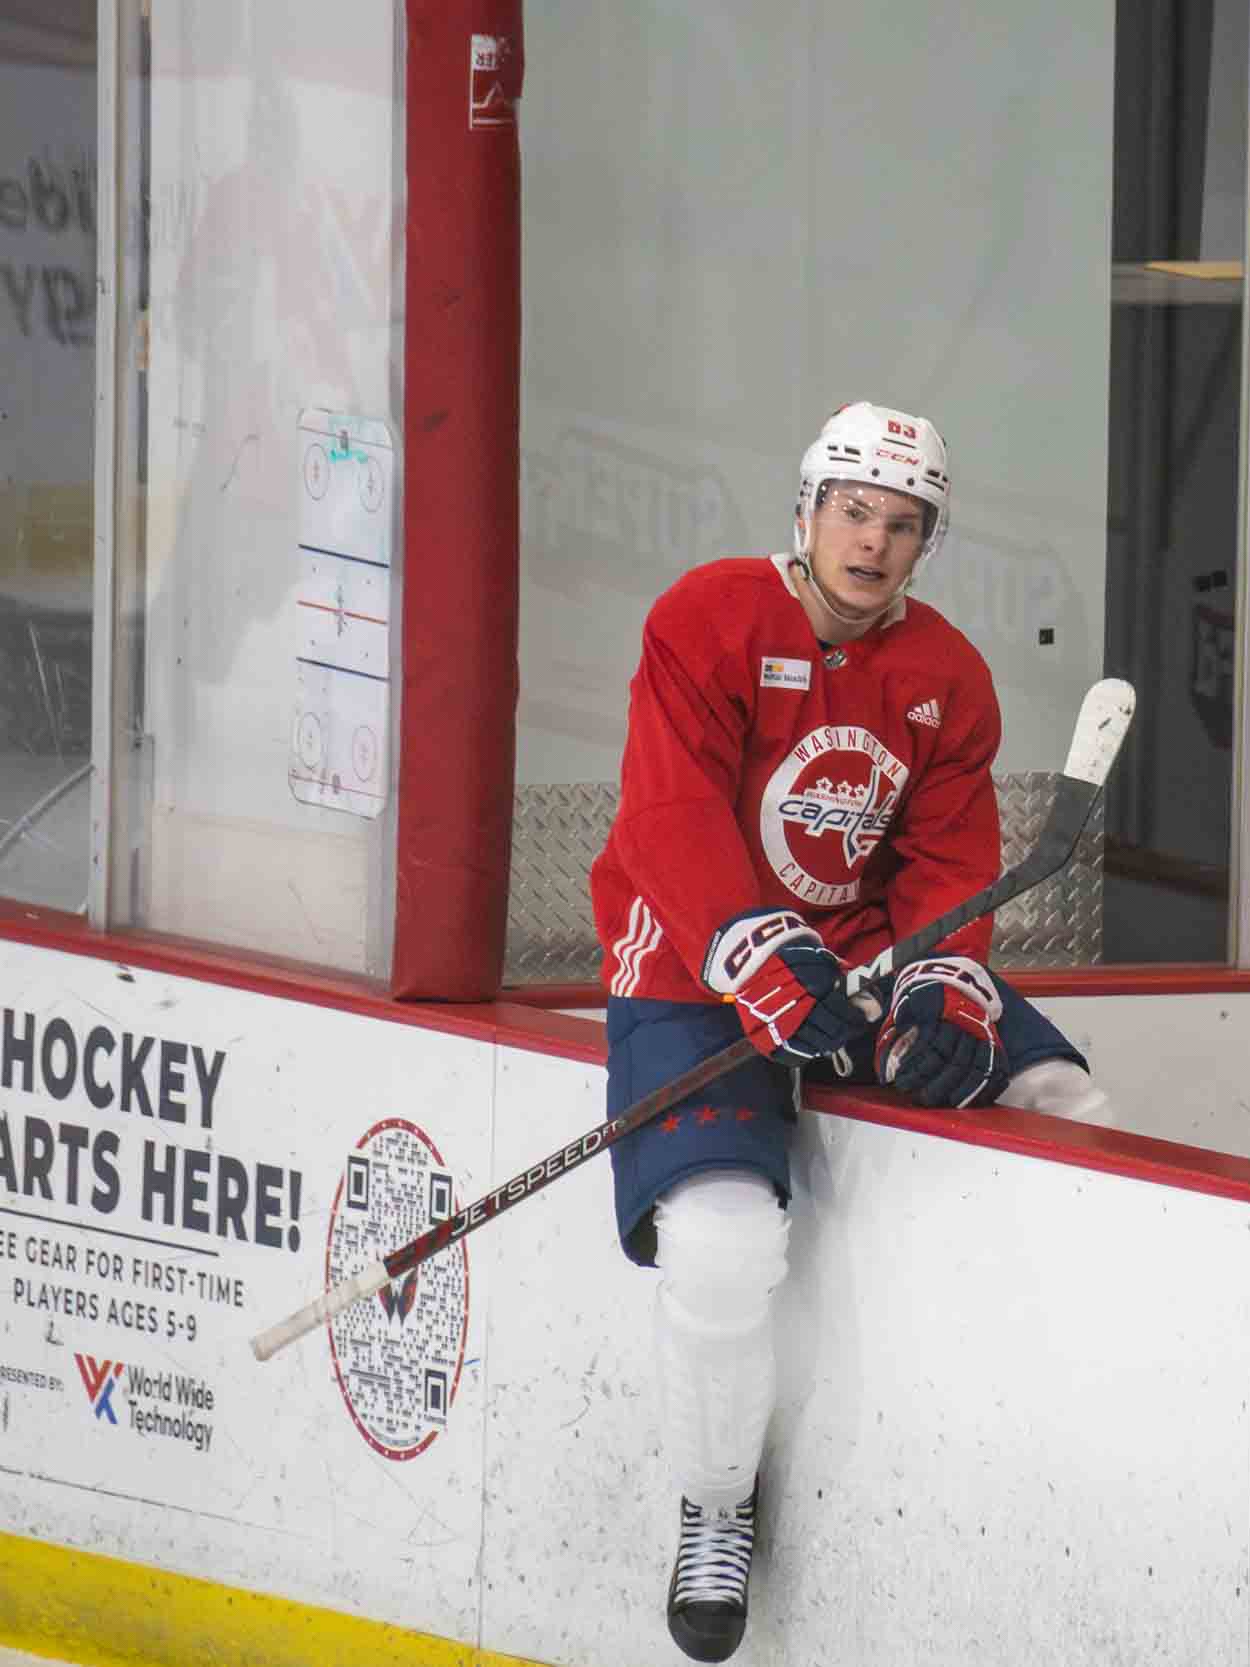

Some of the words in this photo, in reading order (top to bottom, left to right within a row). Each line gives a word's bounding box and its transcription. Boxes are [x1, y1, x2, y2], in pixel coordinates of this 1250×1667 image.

[875, 448, 920, 466] CCM
[1, 1008, 227, 1129] HOCKEY
[141, 1139, 303, 1253] HERE!
[449, 1130, 602, 1237] JETSPEED
[25, 1236, 77, 1273] GEAR
[85, 1247, 124, 1283] FOR
[132, 1258, 245, 1308] FIRST-TIME
[13, 1277, 100, 1322] PLAYERS
[107, 1298, 159, 1334] AGES
[166, 1310, 198, 1342] 5-9
[128, 1364, 171, 1401] World
[175, 1375, 215, 1410] Wide
[128, 1400, 214, 1453] Technology
